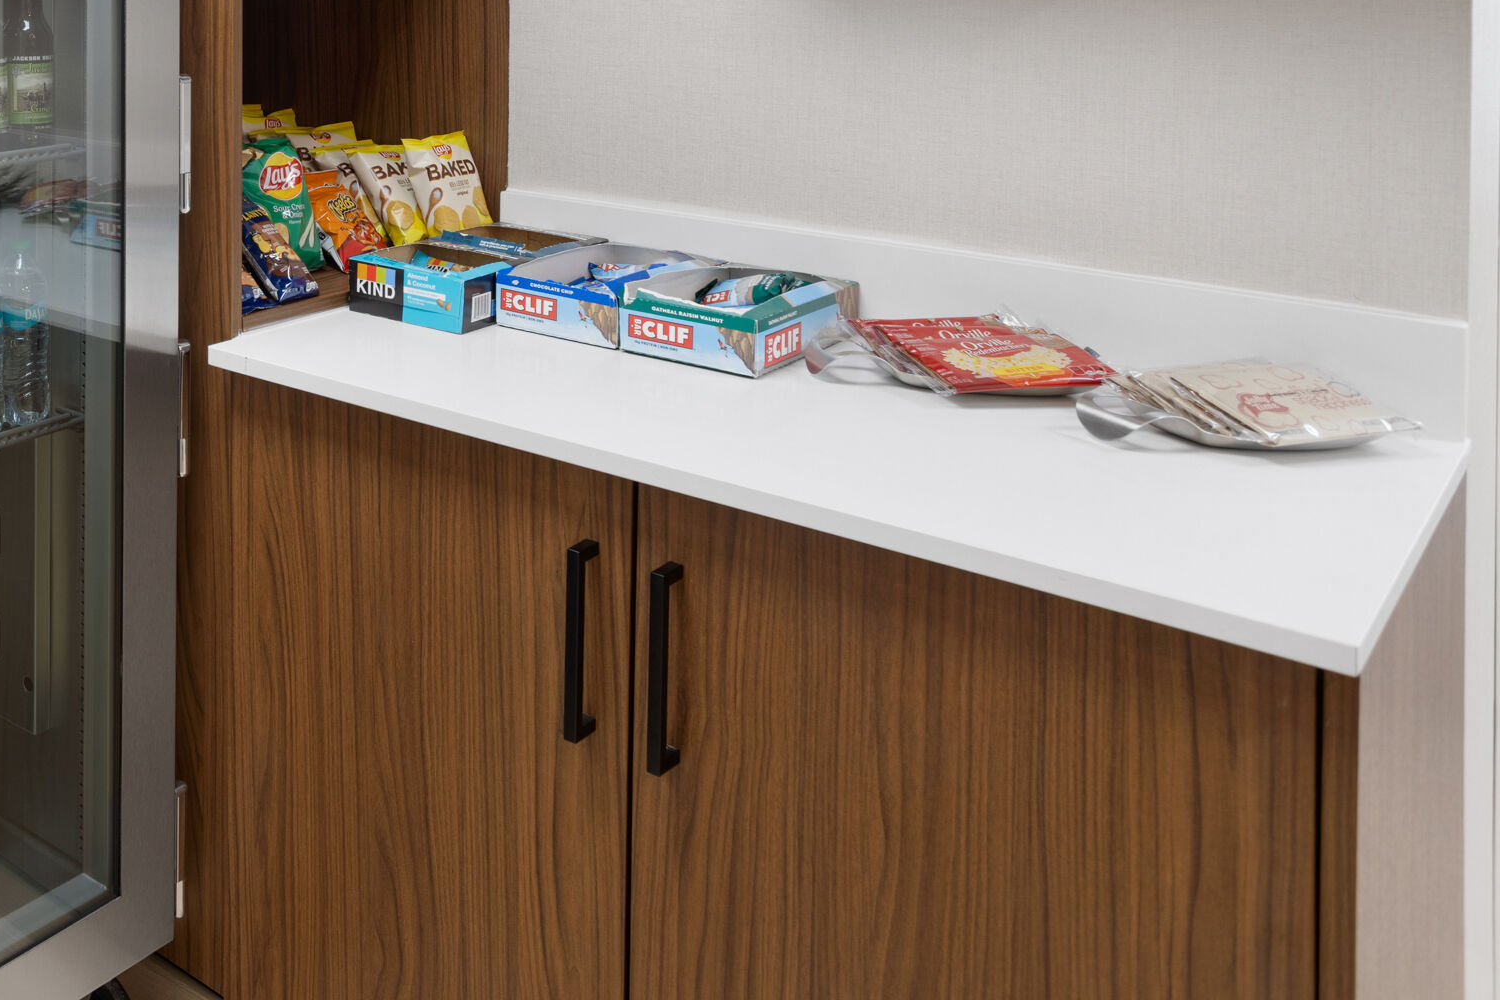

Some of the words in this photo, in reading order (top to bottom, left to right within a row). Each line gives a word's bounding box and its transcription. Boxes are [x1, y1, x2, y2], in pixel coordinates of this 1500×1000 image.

[264, 162, 300, 190] Lay's
[425, 159, 476, 181] BAKED
[273, 205, 290, 213] Sour
[407, 272, 428, 281] Almond
[412, 280, 436, 290] Coconut
[356, 279, 396, 300] KIND
[530, 282, 560, 292] CHOCOLATE
[512, 294, 554, 316] CLIF
[651, 306, 677, 316] OATMEAL
[678, 311, 699, 319] RAISIN
[700, 315, 724, 324] WALNUT
[634, 318, 642, 336] BAR
[642, 321, 690, 344] CLIF
[939, 328, 991, 341] Orville
[773, 327, 800, 359] CLIF
[960, 339, 1012, 351] Orville
